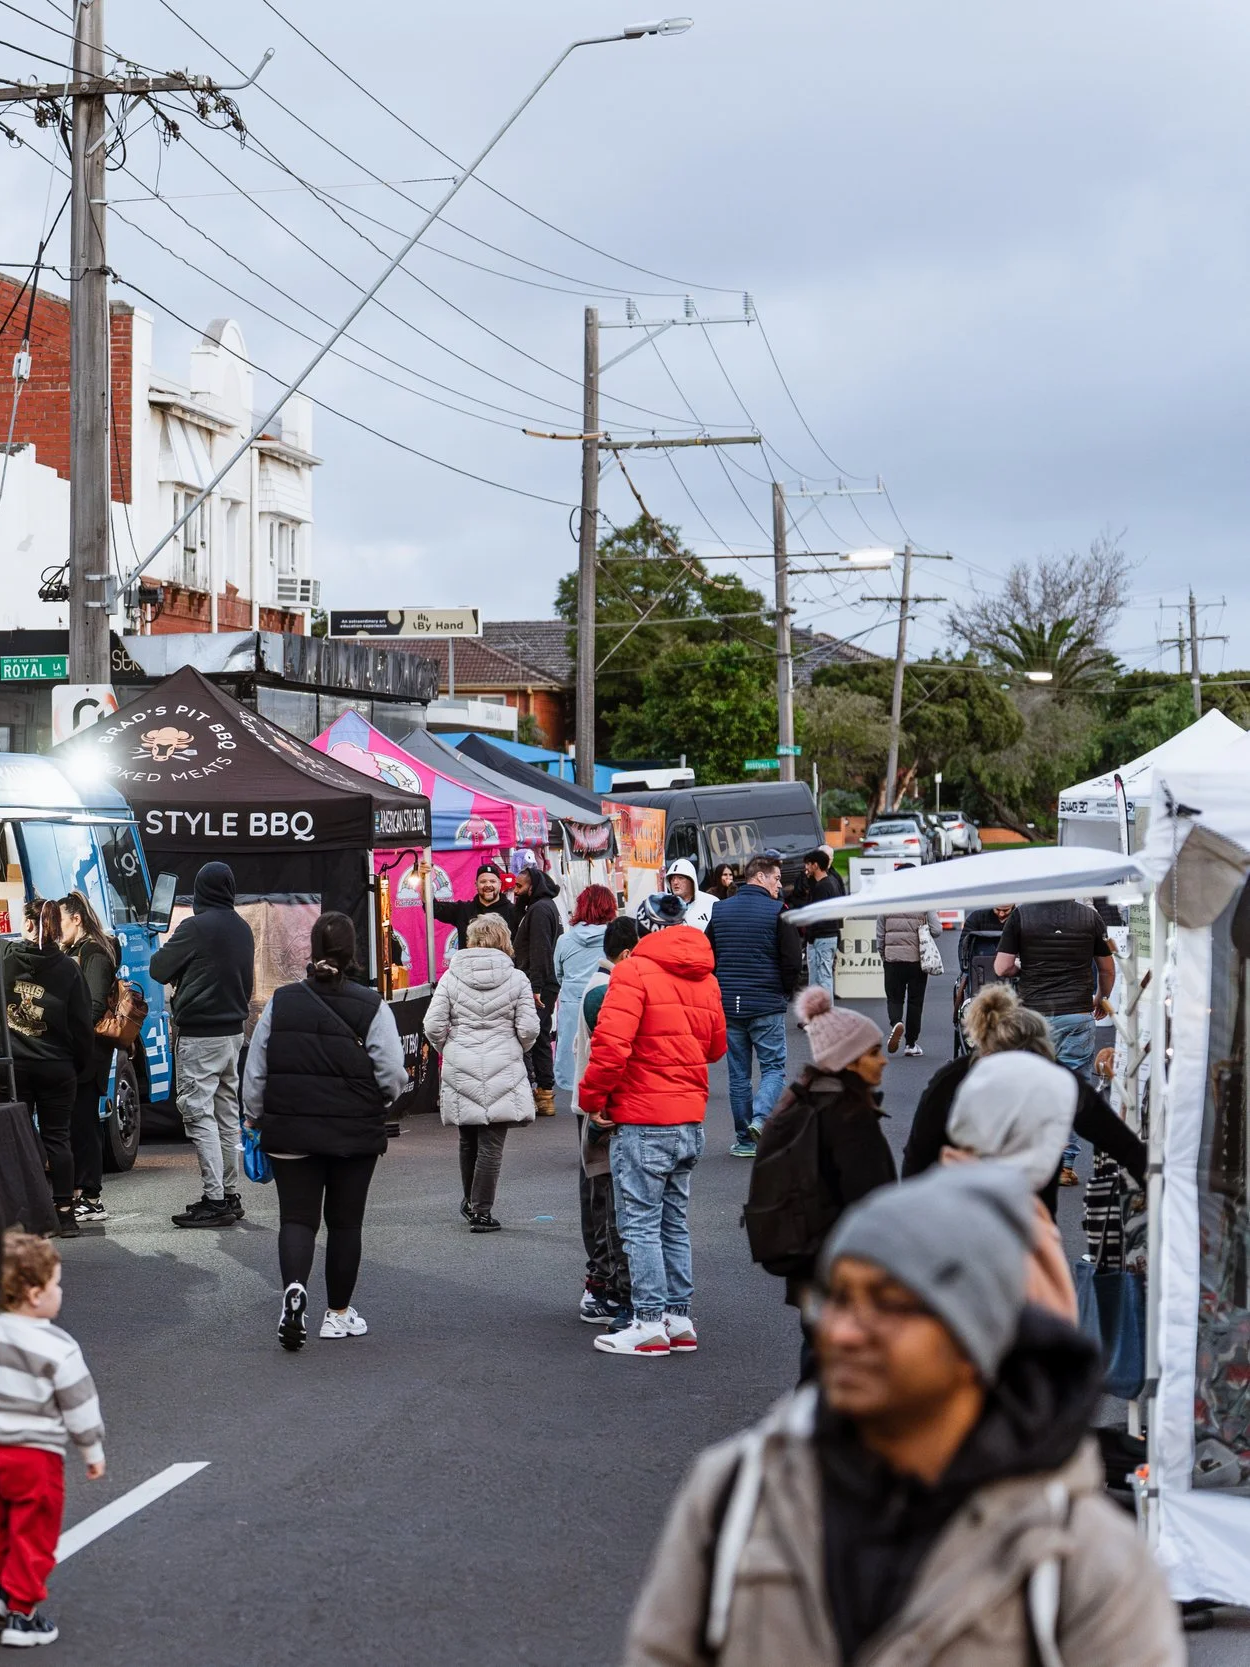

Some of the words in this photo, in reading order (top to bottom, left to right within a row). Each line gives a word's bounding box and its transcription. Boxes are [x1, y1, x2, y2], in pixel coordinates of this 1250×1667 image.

[417, 622, 431, 632] By
[436, 622, 463, 630] Hand
[3, 663, 47, 678] ROYAL
[52, 663, 62, 671] LA
[99, 705, 168, 744] BRAD'S
[175, 704, 211, 721] PIT
[208, 723, 237, 750] BBQ
[171, 756, 232, 782] MEATS
[145, 810, 239, 836] STYLE
[249, 811, 315, 841] BBQ
